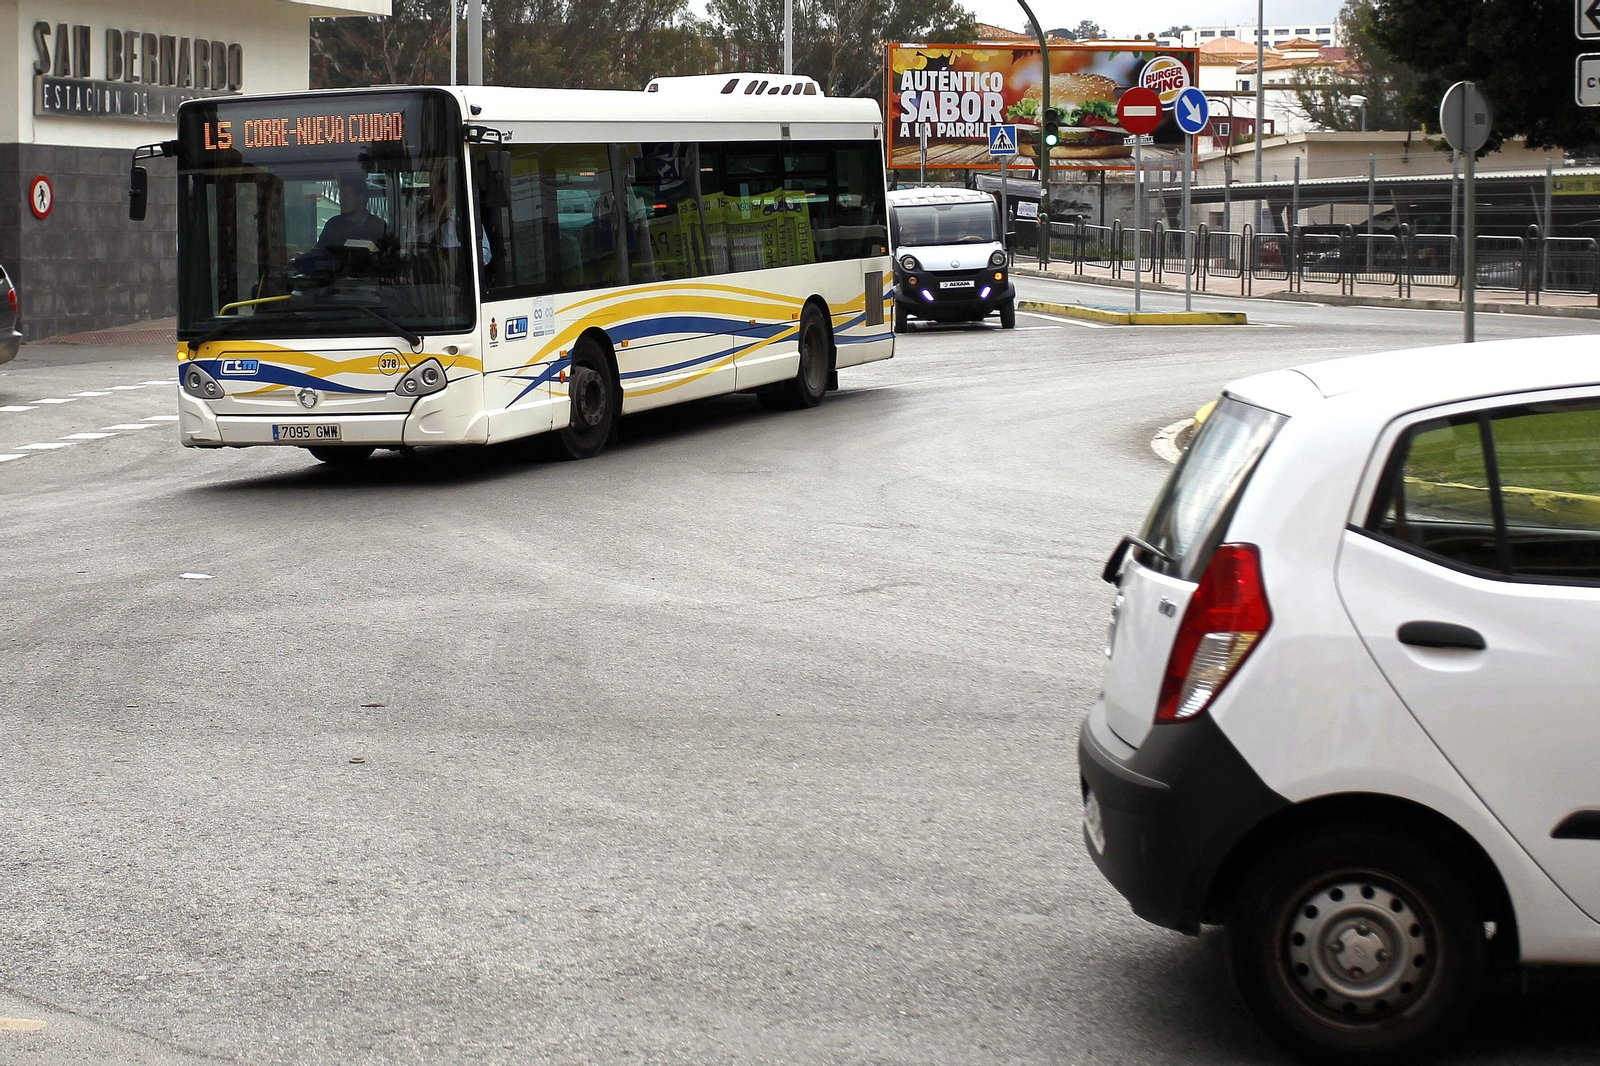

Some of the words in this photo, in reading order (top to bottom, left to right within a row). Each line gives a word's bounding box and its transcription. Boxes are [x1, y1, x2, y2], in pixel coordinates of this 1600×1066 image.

[33, 21, 91, 77] SAN
[105, 28, 243, 90] BERNARDO
[900, 66, 1004, 92] AUTÉNTICO
[1145, 66, 1182, 85] BURGER
[1586, 76, 1600, 88] C
[133, 92, 148, 116] DE
[900, 90, 1004, 123] SABOR
[204, 121, 233, 150] L5
[244, 115, 345, 148] COBRE-NUEVA
[348, 112, 402, 142] CIUDAD
[900, 122, 910, 138] A
[381, 358, 397, 369] 378
[281, 426, 310, 438] 7095
[316, 425, 337, 438] GMW
